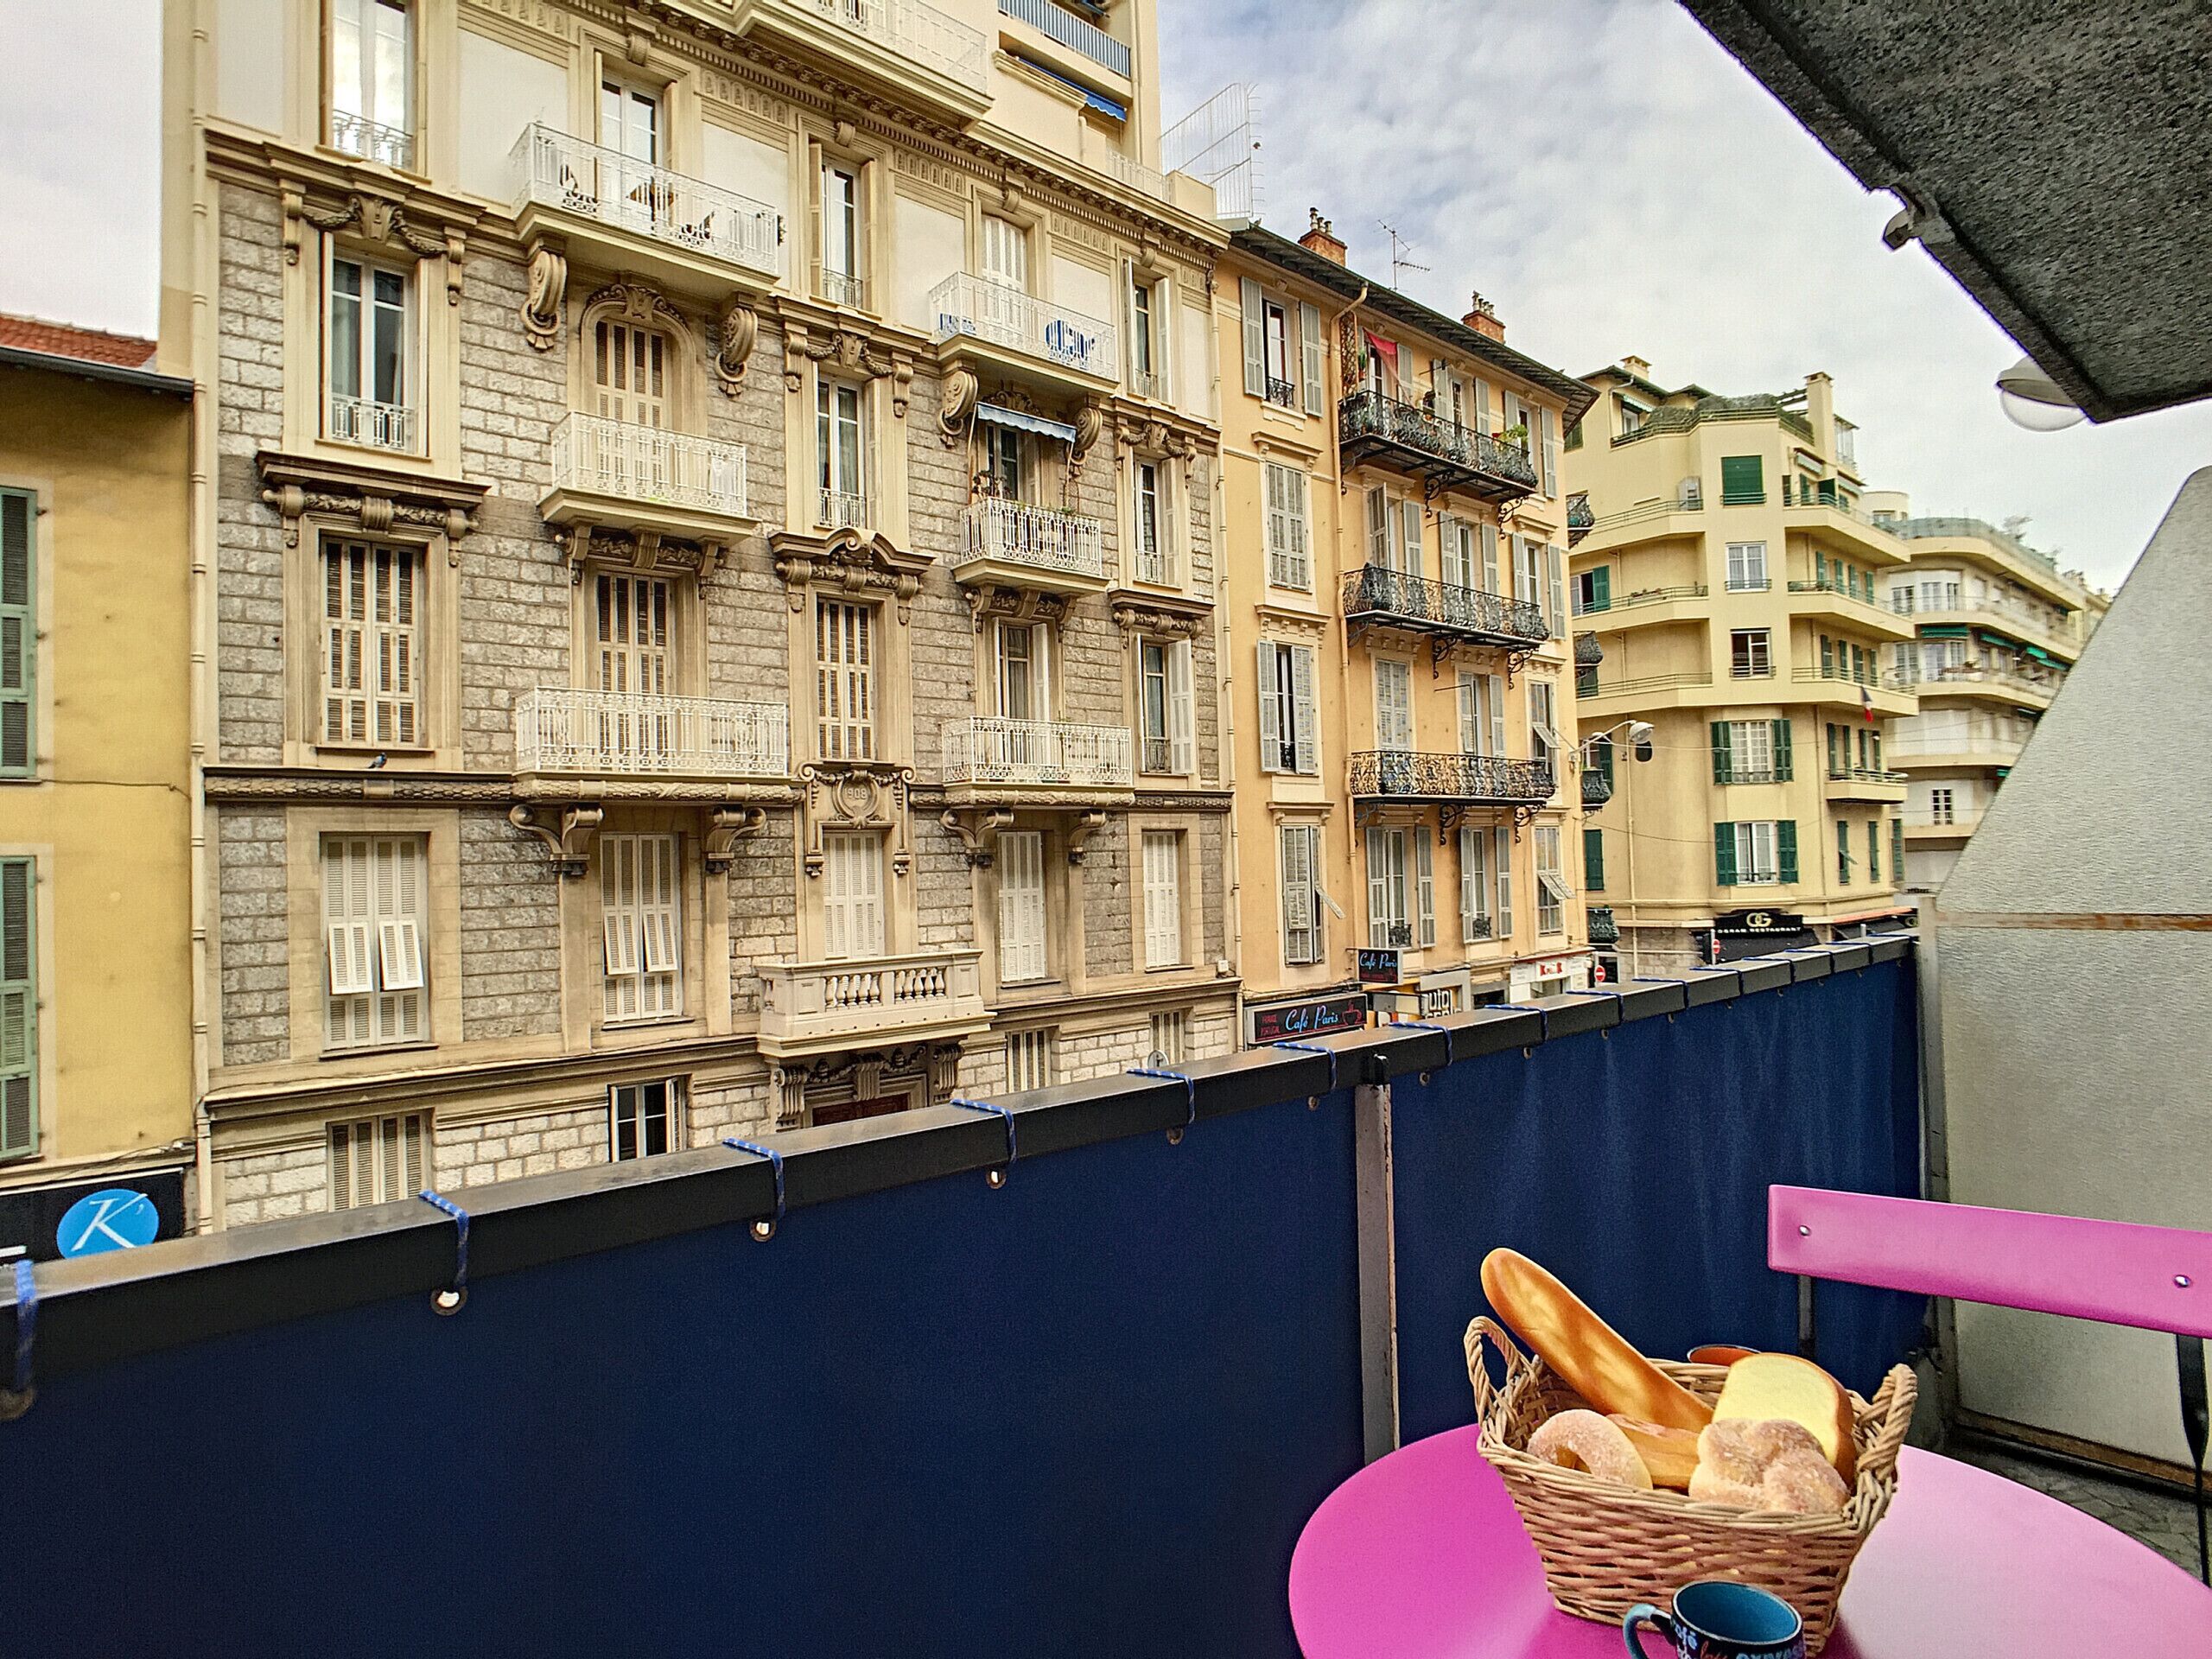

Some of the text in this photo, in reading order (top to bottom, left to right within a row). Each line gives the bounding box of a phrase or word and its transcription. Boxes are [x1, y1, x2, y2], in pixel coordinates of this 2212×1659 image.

[1359, 952, 1397, 969] Café Paris
[1285, 1007, 1308, 1033] Café
[1313, 1004, 1339, 1030] Paris
